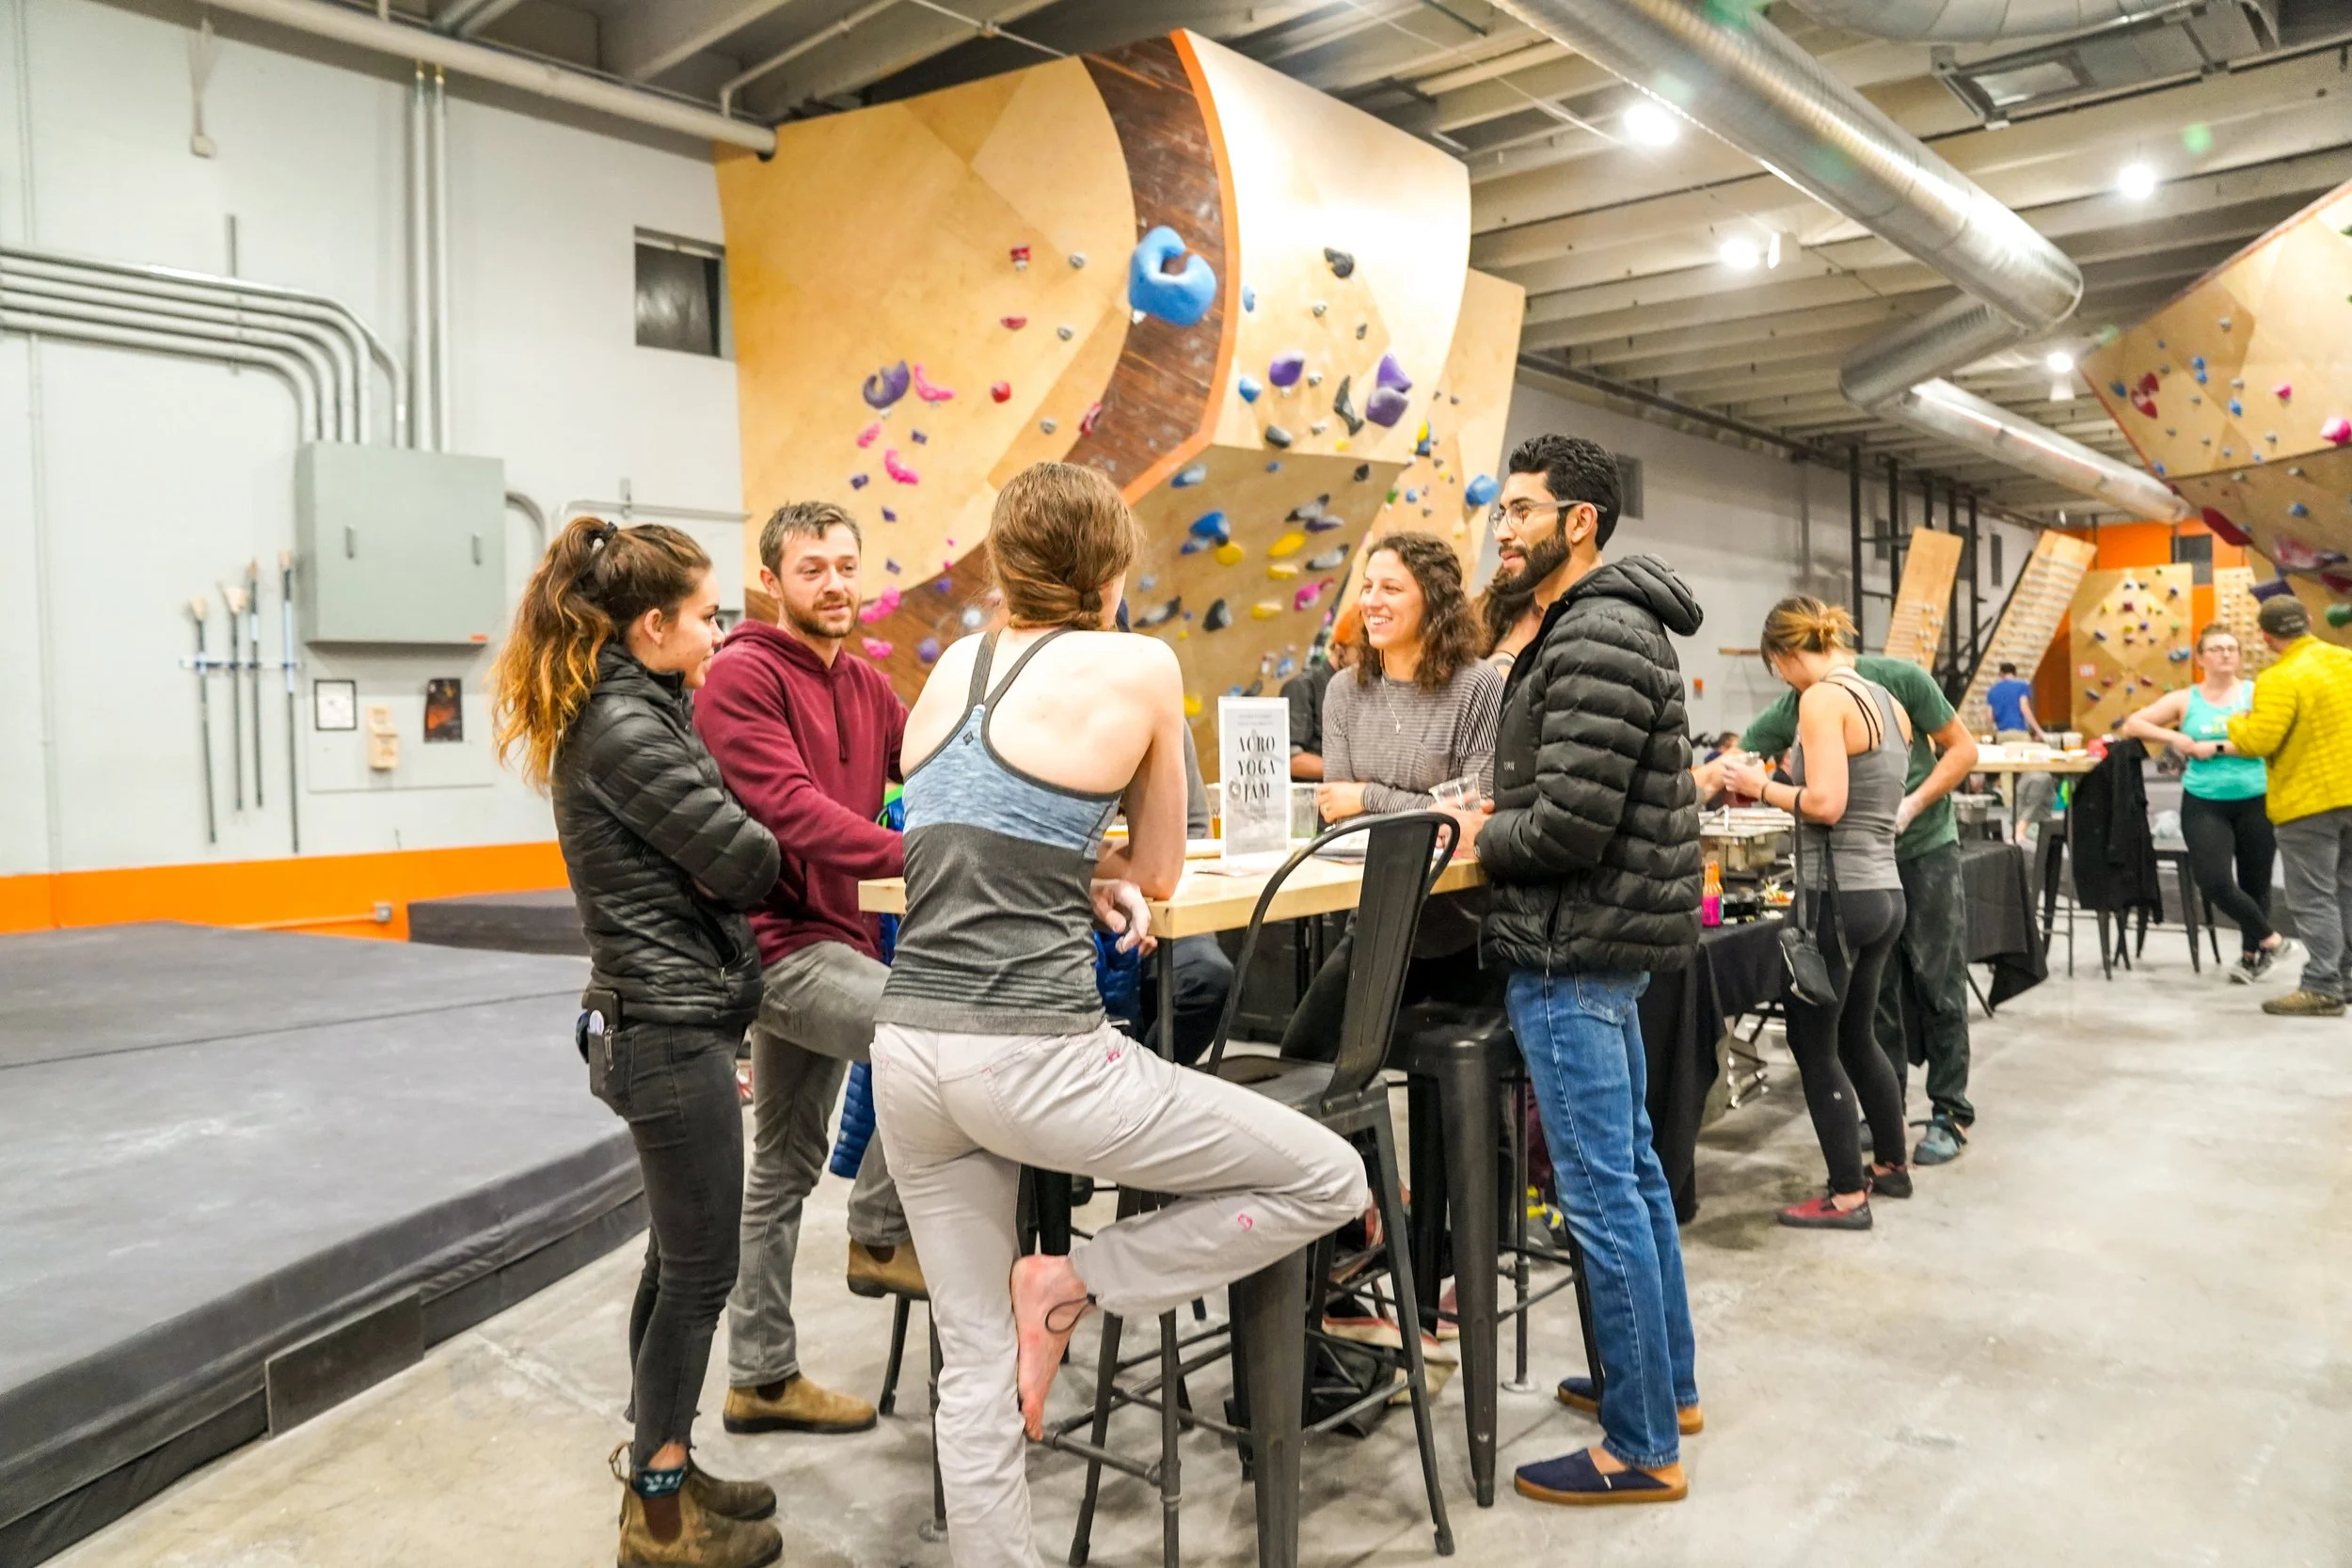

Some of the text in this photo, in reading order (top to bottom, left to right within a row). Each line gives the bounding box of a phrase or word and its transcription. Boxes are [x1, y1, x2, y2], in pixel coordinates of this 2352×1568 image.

[1237, 736, 1275, 752] ACRO
[1238, 759, 1275, 776] YOGA
[1245, 782, 1270, 802] JAM
